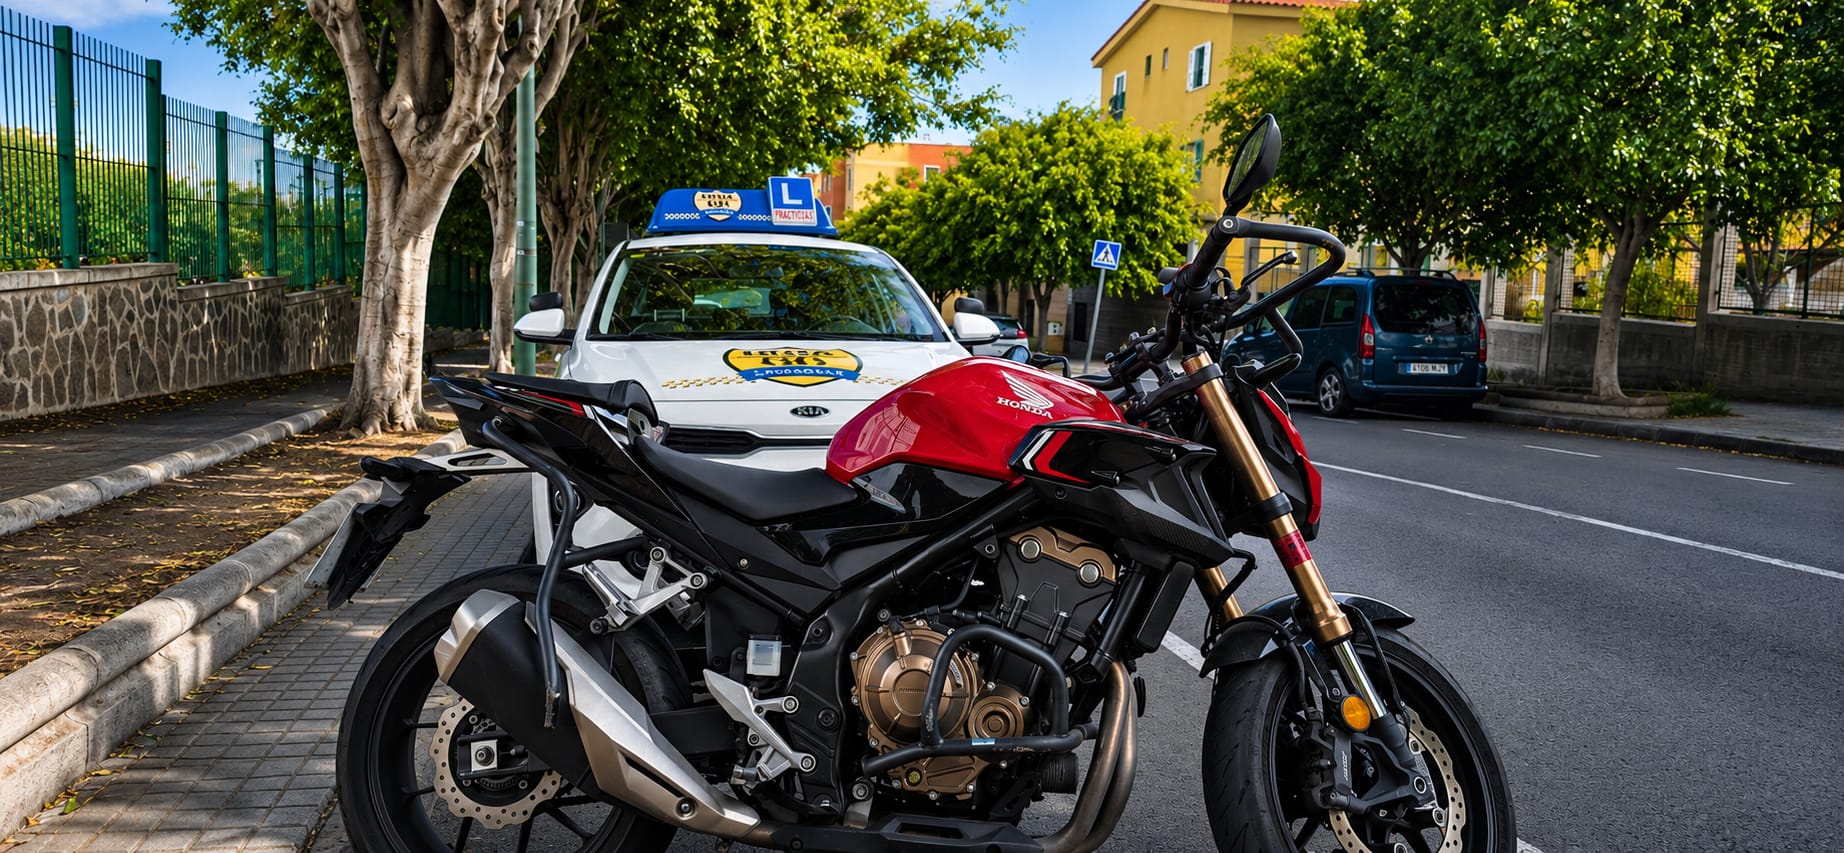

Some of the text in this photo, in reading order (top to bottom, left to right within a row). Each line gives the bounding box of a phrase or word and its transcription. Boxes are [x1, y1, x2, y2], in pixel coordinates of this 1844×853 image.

[781, 182, 803, 205] L
[797, 406, 825, 415] KIA
[996, 396, 1054, 420] HONDA
